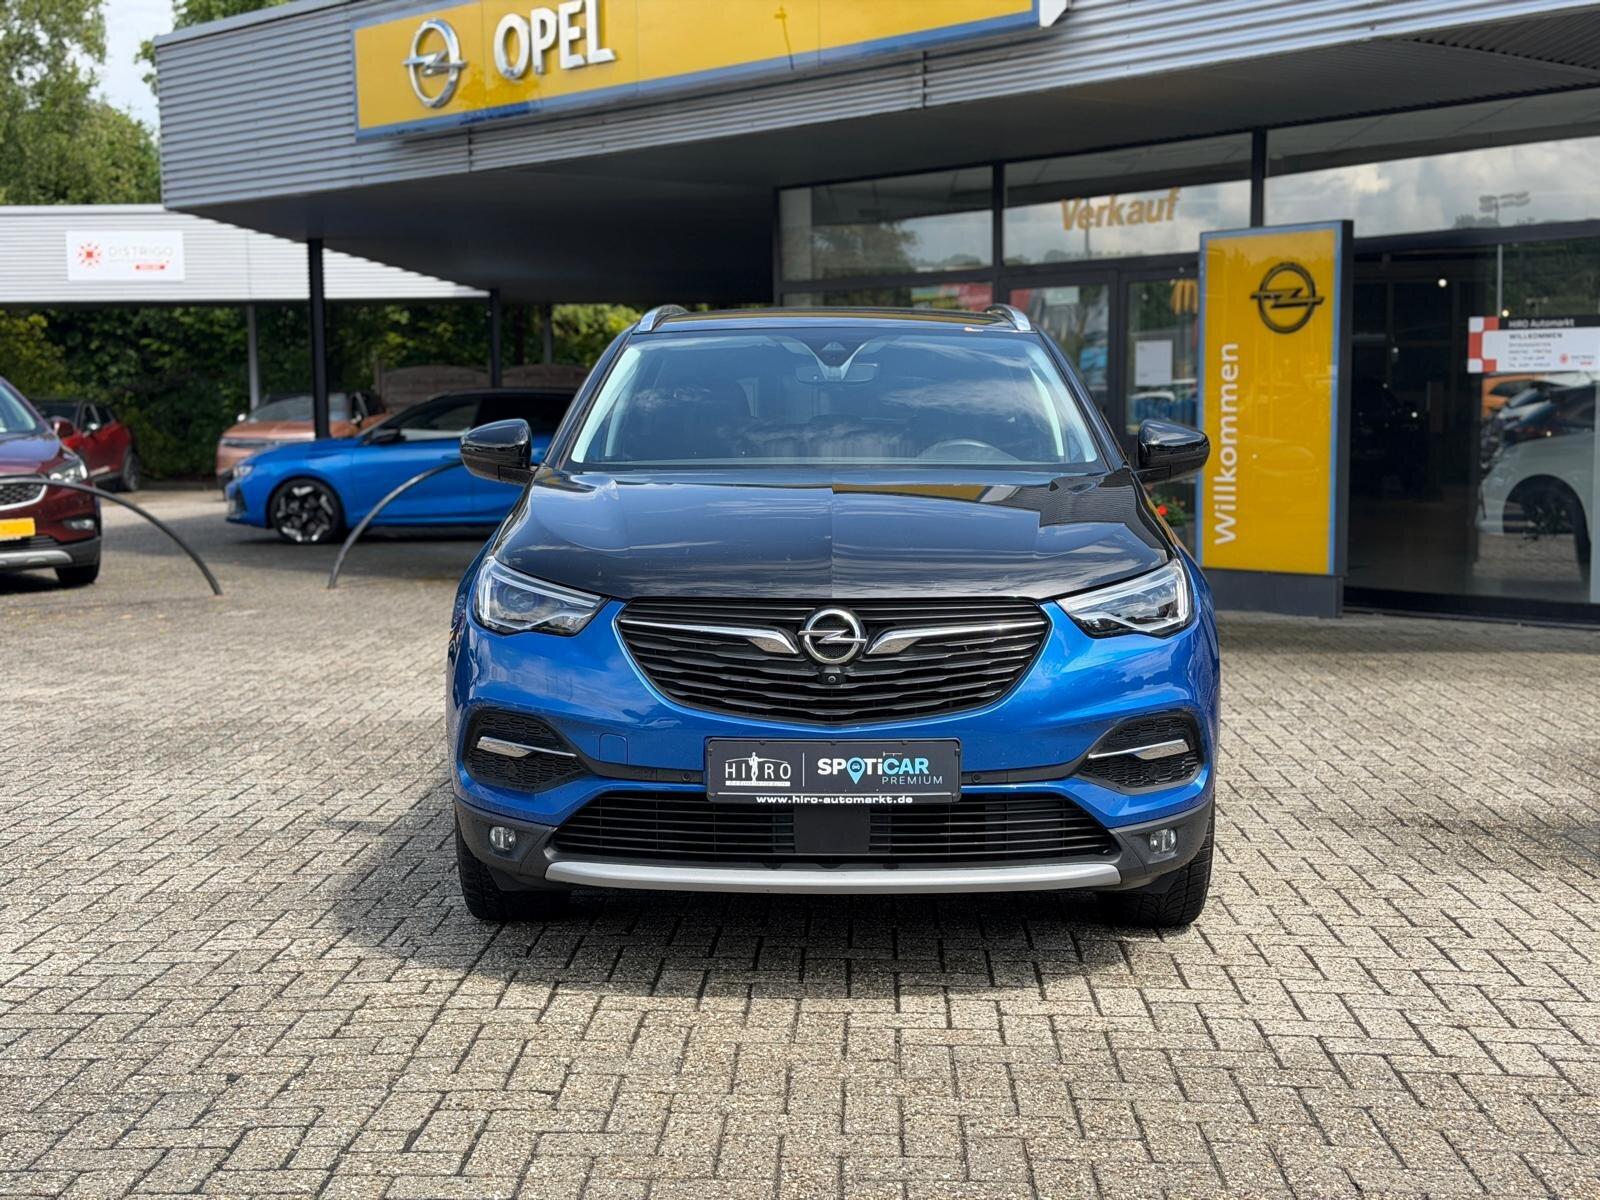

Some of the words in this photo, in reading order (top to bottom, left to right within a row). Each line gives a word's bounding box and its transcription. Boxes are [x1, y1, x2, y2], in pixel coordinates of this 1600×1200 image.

[494, 0, 616, 80] OPEL
[1060, 187, 1180, 231] Verkauf
[108, 246, 174, 257] DISTRIGO
[1213, 343, 1239, 545] Willkommen
[725, 763, 791, 780] HIRO
[882, 776, 943, 785] PREMIUM
[756, 795, 913, 804] www.hiro-automarkt.de
